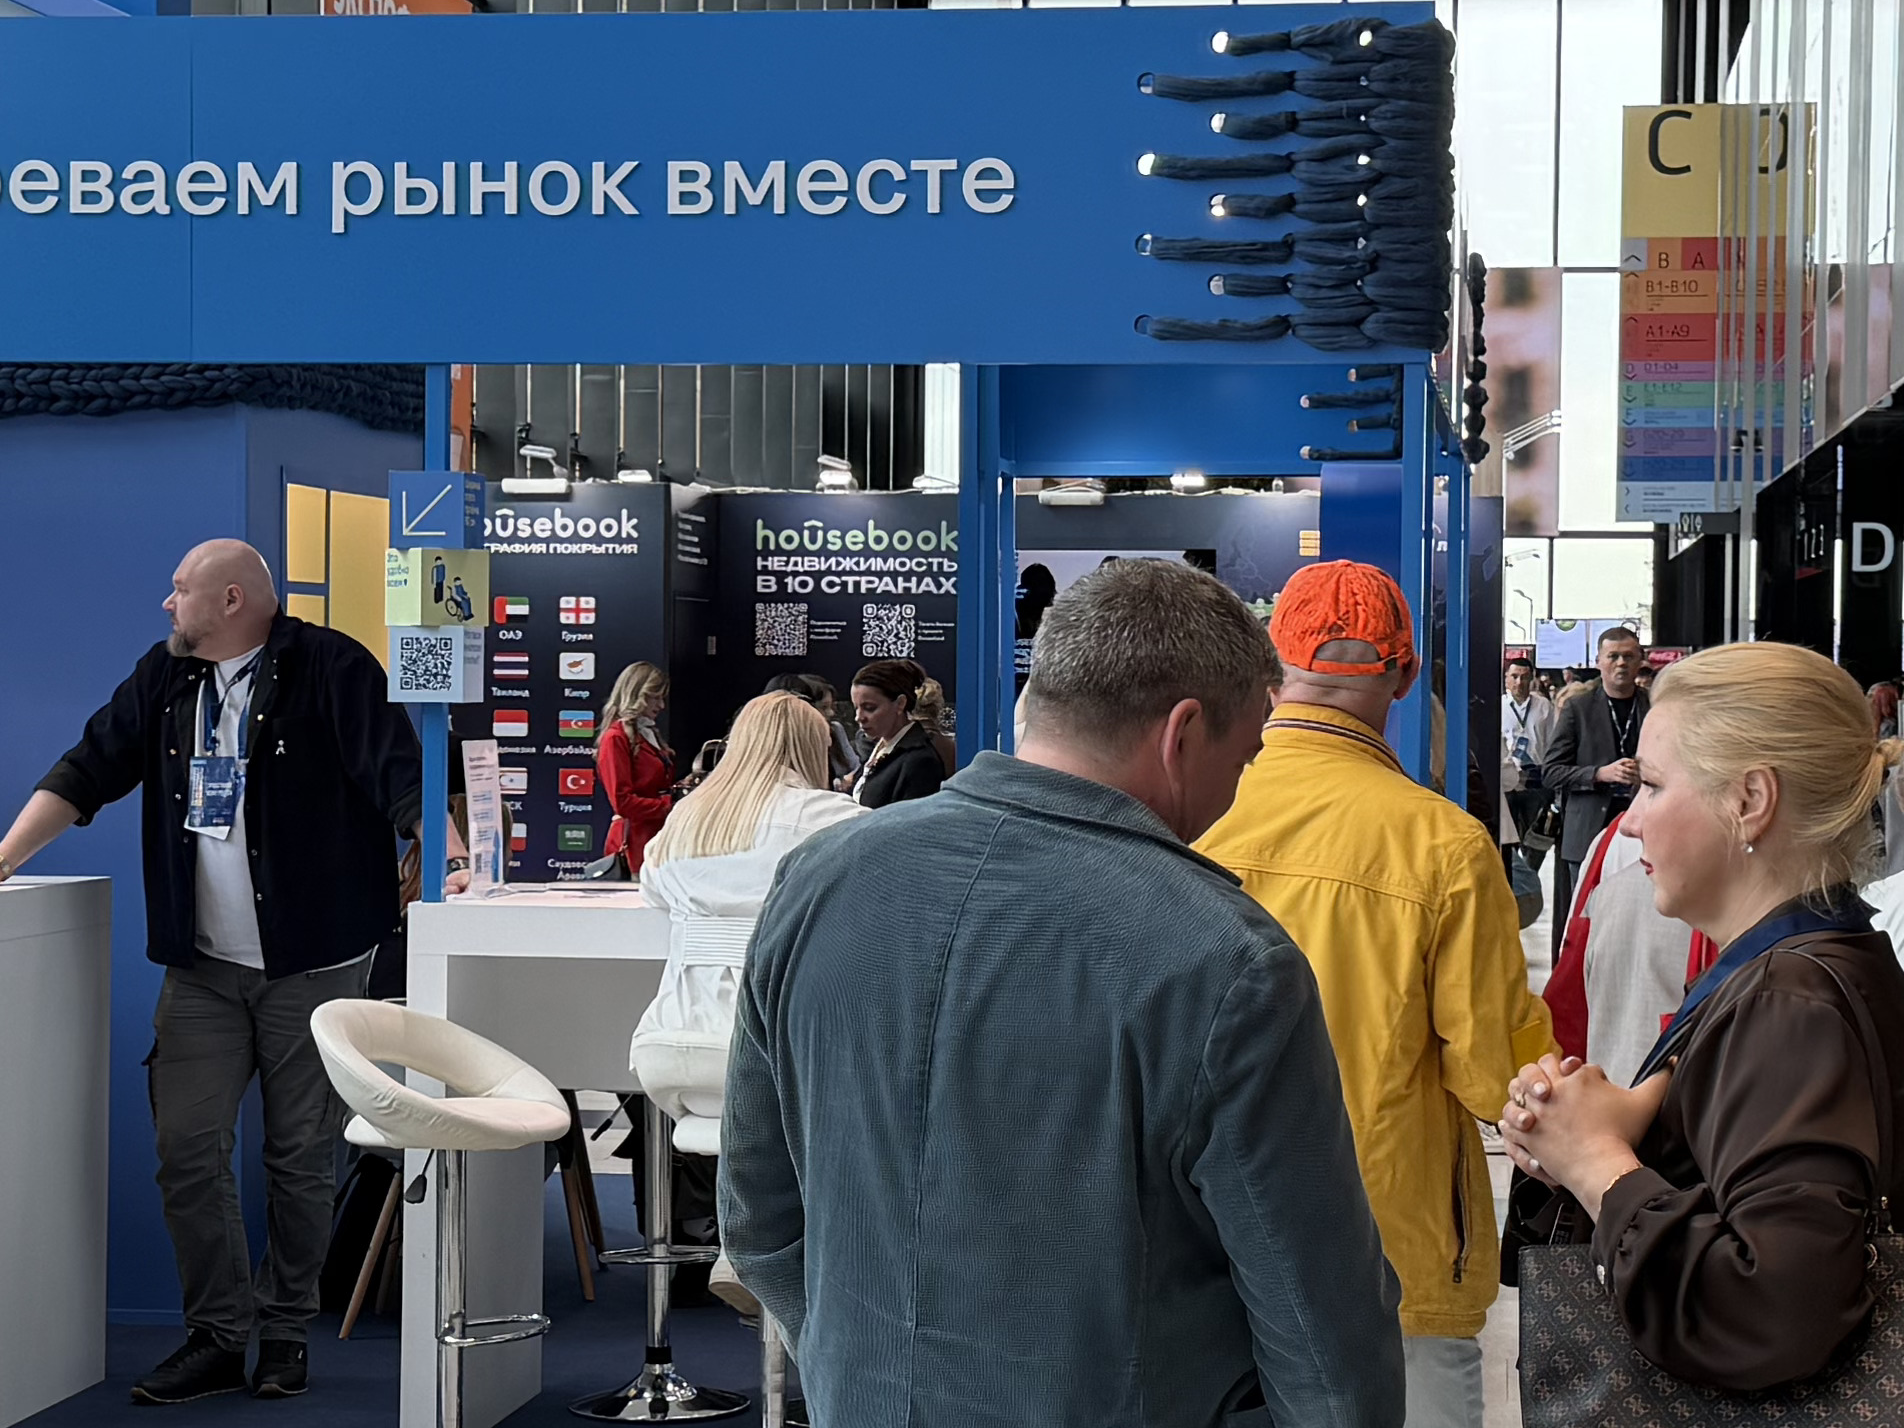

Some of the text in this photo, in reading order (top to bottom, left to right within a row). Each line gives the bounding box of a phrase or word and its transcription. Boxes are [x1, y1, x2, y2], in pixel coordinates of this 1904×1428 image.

[1648, 109, 1693, 175] C
[330, 158, 639, 232] рынок
[668, 157, 1017, 215] вместе
[1658, 252, 1705, 269] B A
[1646, 279, 1699, 294] B1-B10
[1646, 324, 1690, 337] A1-A9
[484, 507, 639, 538] usebook
[549, 543, 639, 554] ПОКРЫТИЯ
[756, 556, 958, 573] НЕДВИЖИМОСТЬ
[756, 576, 958, 595] В 10 СТРАНАХ
[499, 629, 594, 642] ОАЭ Грузия
[564, 687, 590, 700] Кипр
[558, 800, 593, 813] Турция
